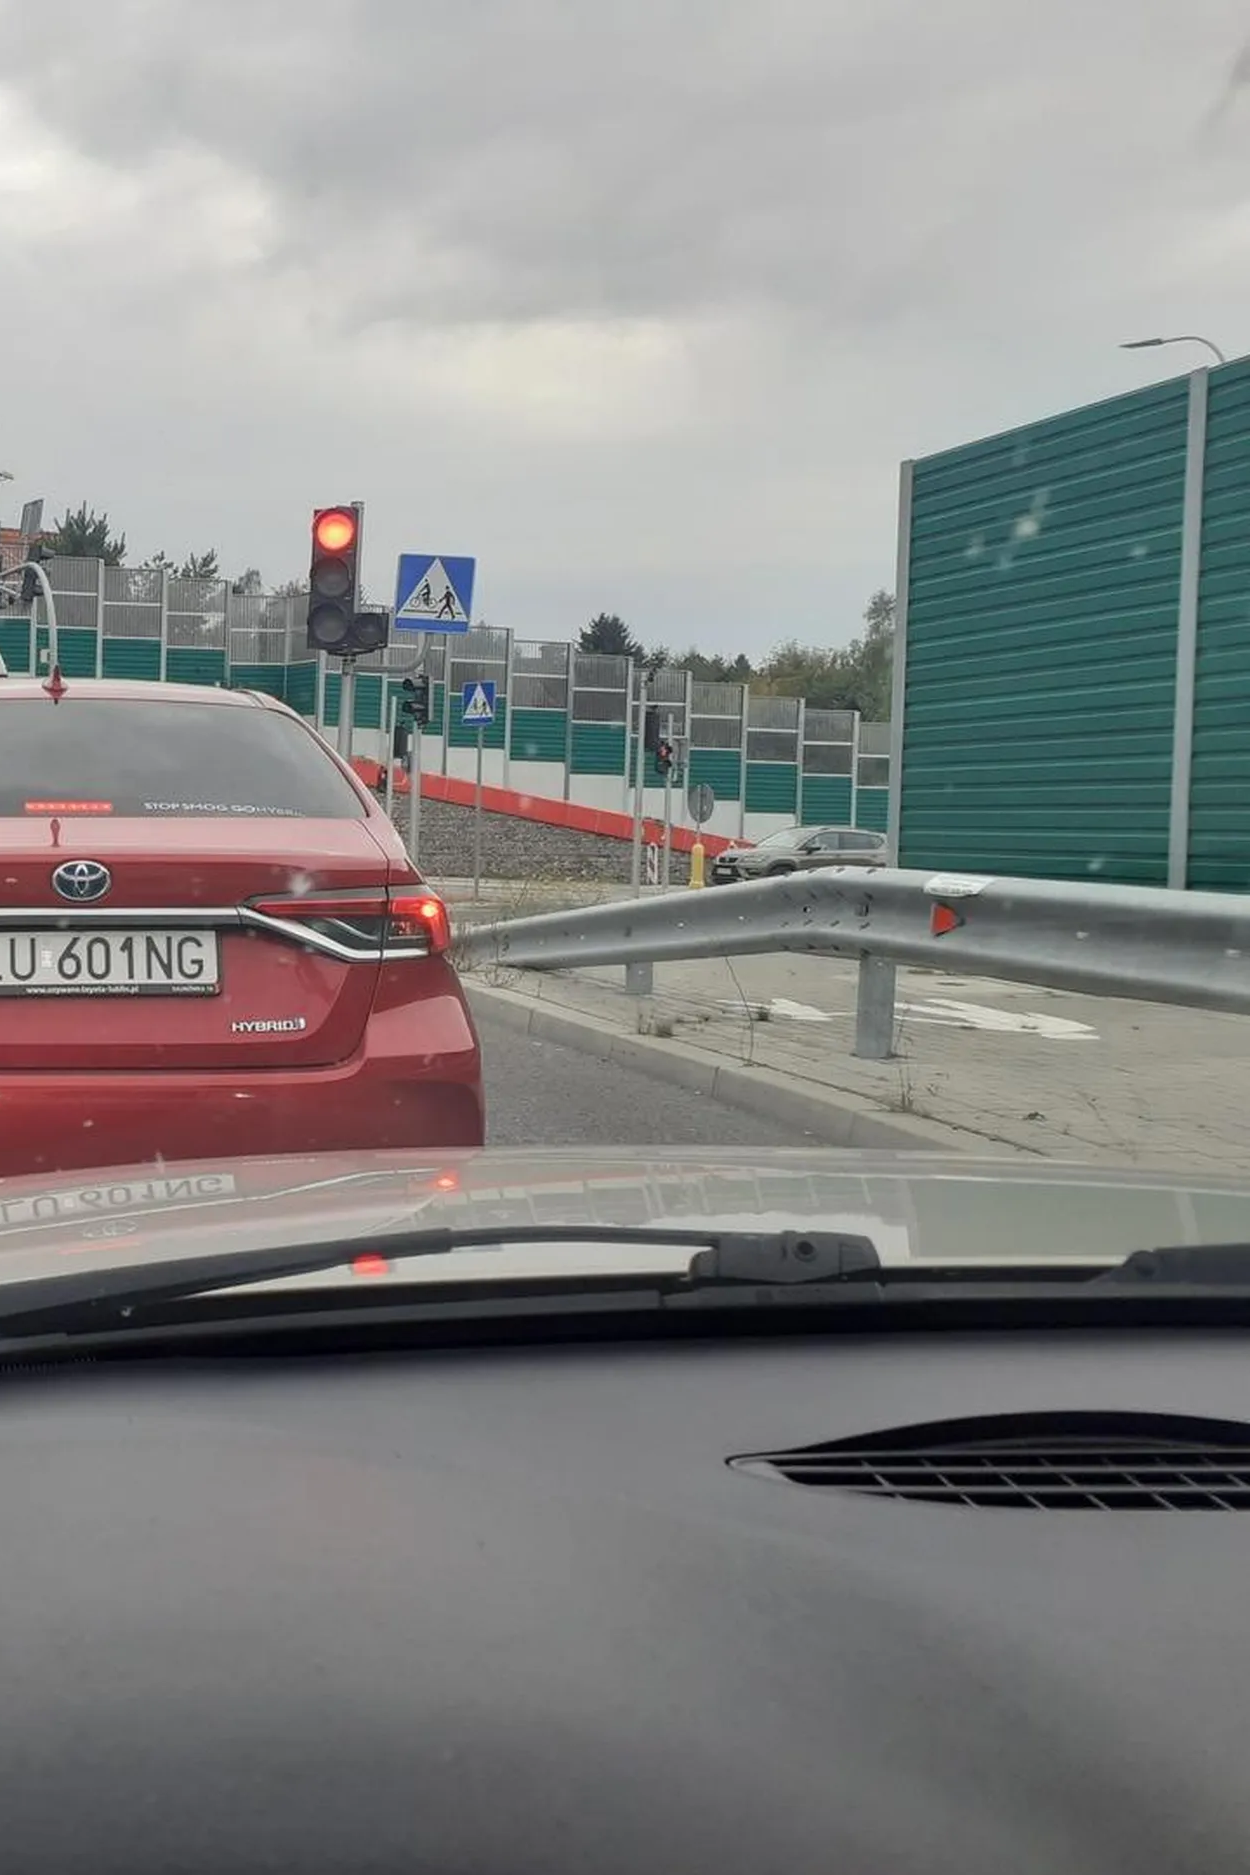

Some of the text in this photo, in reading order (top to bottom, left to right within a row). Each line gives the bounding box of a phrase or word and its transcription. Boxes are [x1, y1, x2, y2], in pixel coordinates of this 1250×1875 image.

[143, 801, 180, 811] STOP
[182, 802, 228, 812] SMOG
[230, 804, 255, 814] GO
[56, 935, 206, 981] 601NG
[231, 1019, 295, 1033] HYBRID
